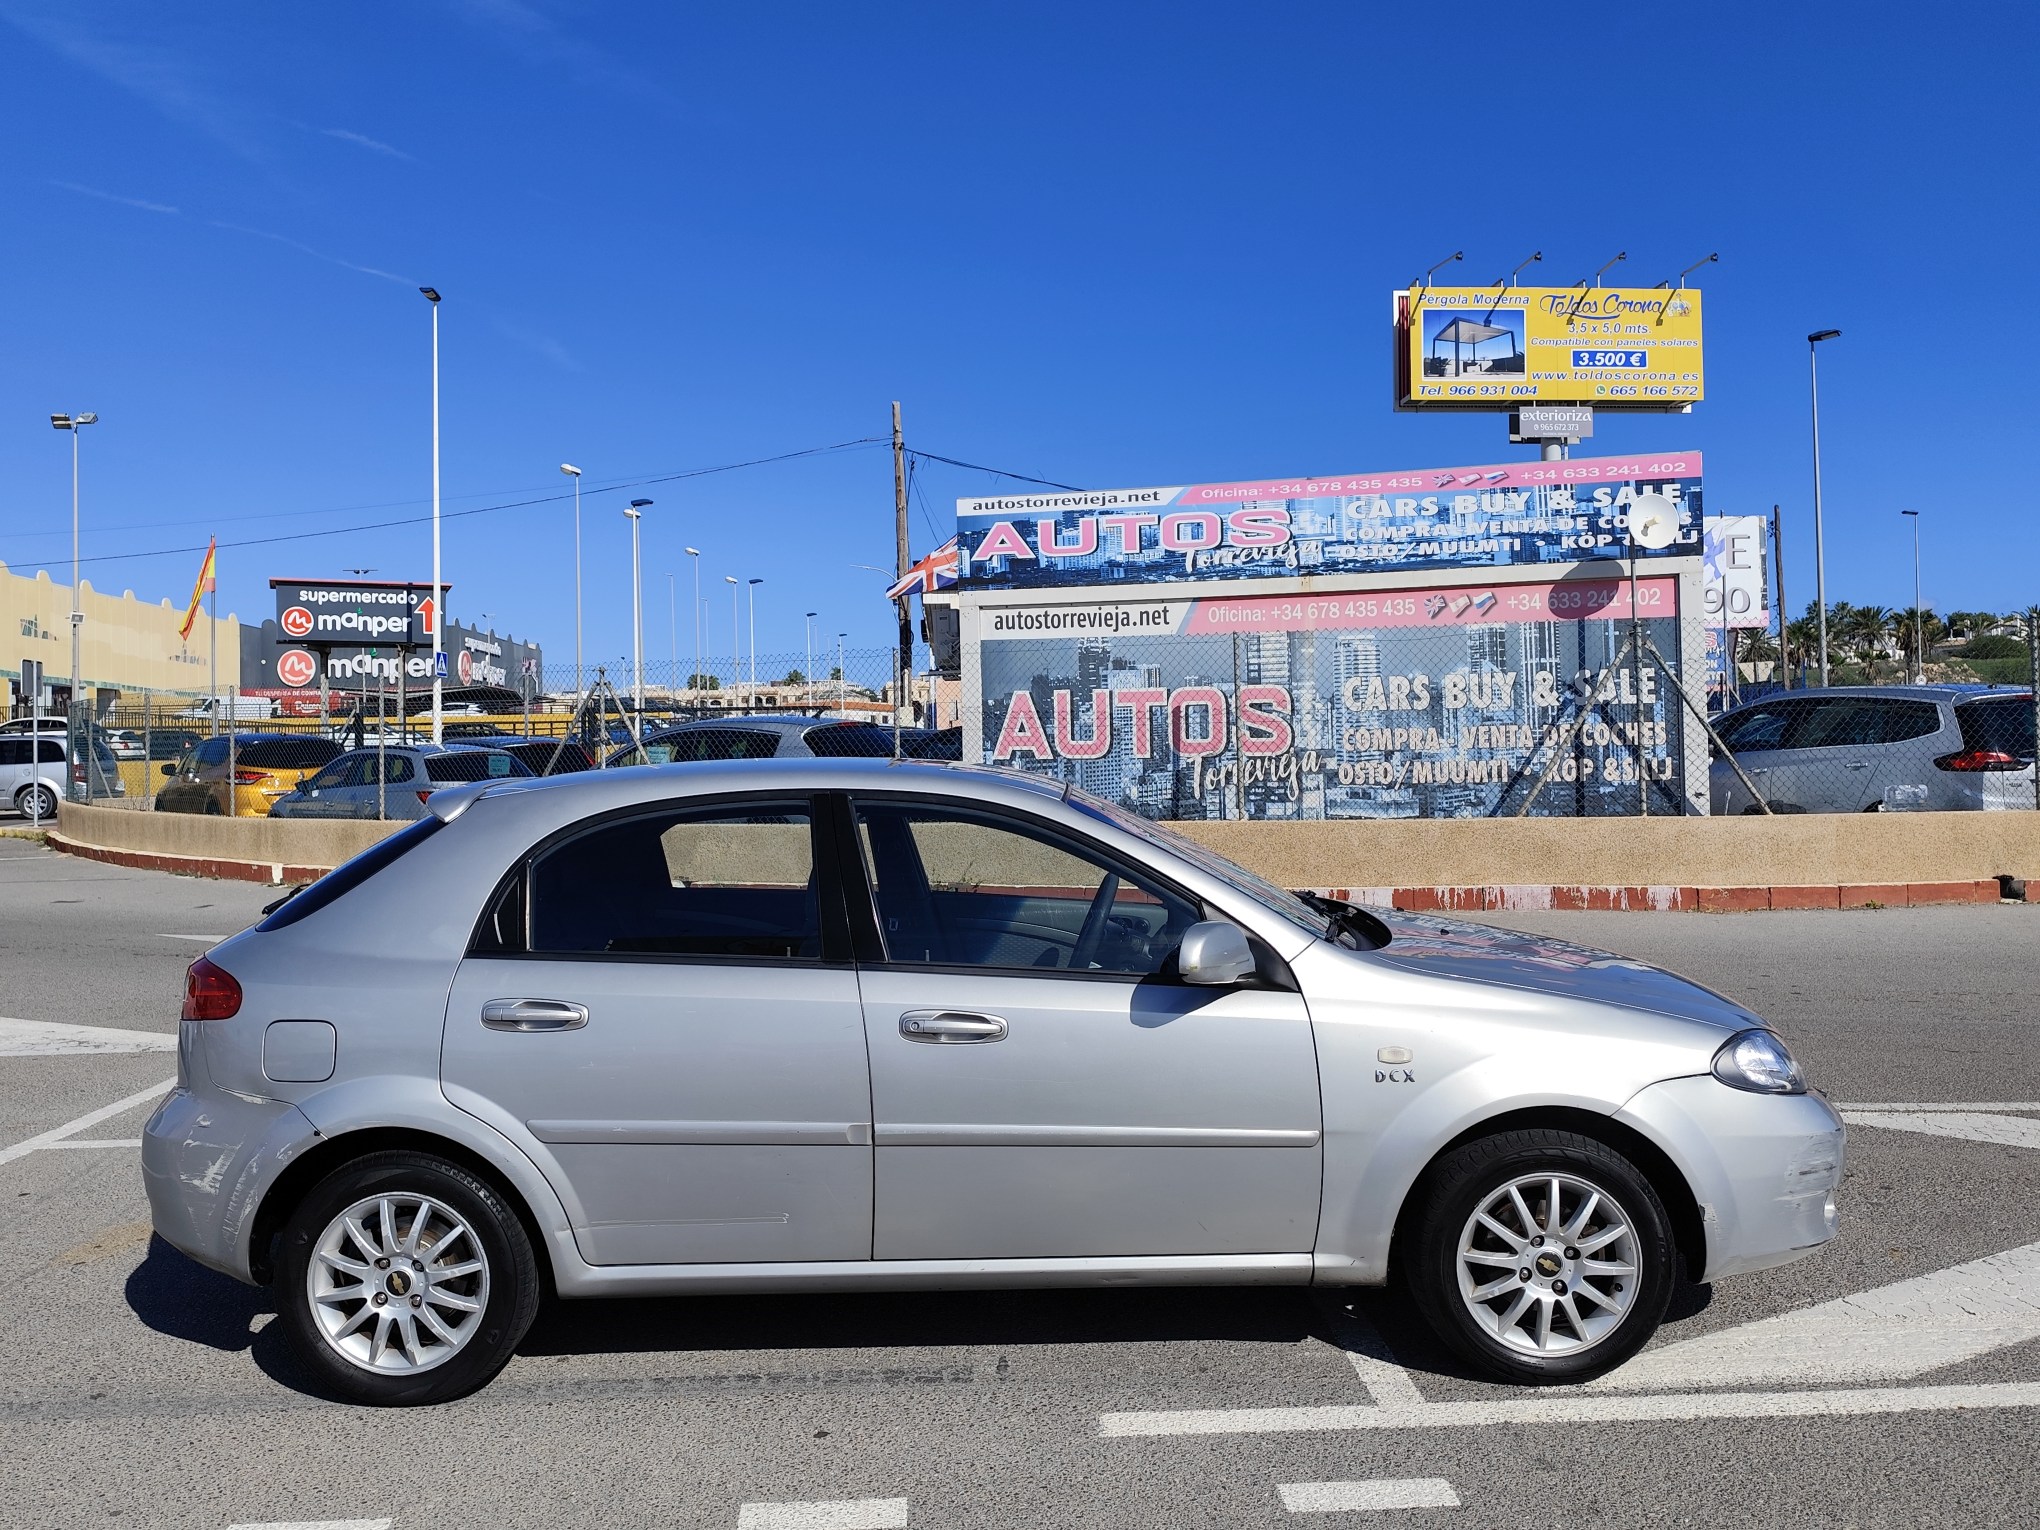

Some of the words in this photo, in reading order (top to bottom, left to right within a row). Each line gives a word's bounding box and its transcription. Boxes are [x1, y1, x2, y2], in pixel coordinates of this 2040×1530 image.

[1419, 293, 1468, 307] Pérgola
[1473, 294, 1530, 305] Moderna
[1539, 294, 1597, 318] Toldos
[1603, 293, 1663, 315] Corona
[1568, 323, 1587, 334] 3,5
[1591, 325, 1598, 333] x
[1603, 323, 1621, 334] 5,0
[1625, 324, 1652, 334] mts.
[1530, 337, 1591, 347] Compatible
[1594, 338, 1613, 346] con
[1617, 338, 1657, 348] paneles
[1660, 337, 1698, 347] solares
[1578, 352, 1625, 366] 3.500
[1630, 353, 1642, 366] €
[1532, 371, 1699, 381] www.toldoscorona.es
[1419, 385, 1444, 396] Tel.
[1449, 385, 1476, 396] 966
[1480, 385, 1506, 396] 931
[1511, 385, 1538, 396] 004
[1610, 385, 1638, 396] 665
[1642, 385, 1667, 396] 166
[1671, 385, 1699, 396] 572
[1520, 409, 1592, 422] exterioriza
[1540, 423, 1553, 432] 965
[1554, 423, 1567, 432] 672
[1567, 423, 1580, 432] 373
[1201, 486, 1263, 499] Oficina:
[1268, 483, 1302, 495] +34
[1307, 481, 1343, 493] 678
[1346, 479, 1382, 491] 435
[1387, 477, 1423, 488] 435
[1521, 470, 1557, 480] +34
[1563, 467, 1600, 478] 633
[1606, 465, 1642, 475] 241
[1648, 462, 1686, 472] 402
[972, 490, 1161, 512] autostorrevieja.net
[1346, 496, 1439, 519] CARS
[1455, 491, 1533, 514] BUY
[1550, 489, 1577, 509] &
[1593, 483, 1682, 508] SAE
[970, 509, 1293, 562] AUTOS
[1345, 523, 1450, 541] COMPRA
[1471, 518, 1550, 535] VENTA
[1557, 516, 1589, 531] DE
[1562, 531, 1614, 549] KÖP
[1184, 538, 1324, 573] Torrevieja
[1726, 534, 1751, 570] E
[299, 588, 418, 606] supermercado
[1208, 606, 1267, 623] Oficina:
[1271, 603, 1303, 620] +34
[1307, 602, 1340, 619] 678
[1344, 600, 1378, 617] 435
[1382, 598, 1416, 616] 435
[1507, 592, 1541, 610] +34
[1549, 592, 1582, 609] 633
[1587, 590, 1621, 607] 241
[1625, 588, 1661, 605] 402
[317, 608, 412, 638] manper
[993, 605, 1170, 632] autostorrevieja.net
[327, 653, 434, 685] manper
[1343, 674, 1431, 712] CARS
[1445, 671, 1517, 709] BUY
[1532, 670, 1561, 707] &
[1574, 667, 1656, 706] SALE
[993, 684, 1294, 760] AUTOS
[1342, 727, 1440, 751] COMPRA
[1462, 723, 1534, 750] VENTA
[1582, 722, 1667, 746] COCHES
[1184, 748, 1323, 802] Torrevieja
[1546, 752, 1594, 782] KÖP
[1374, 1068, 1416, 1083] DCX
